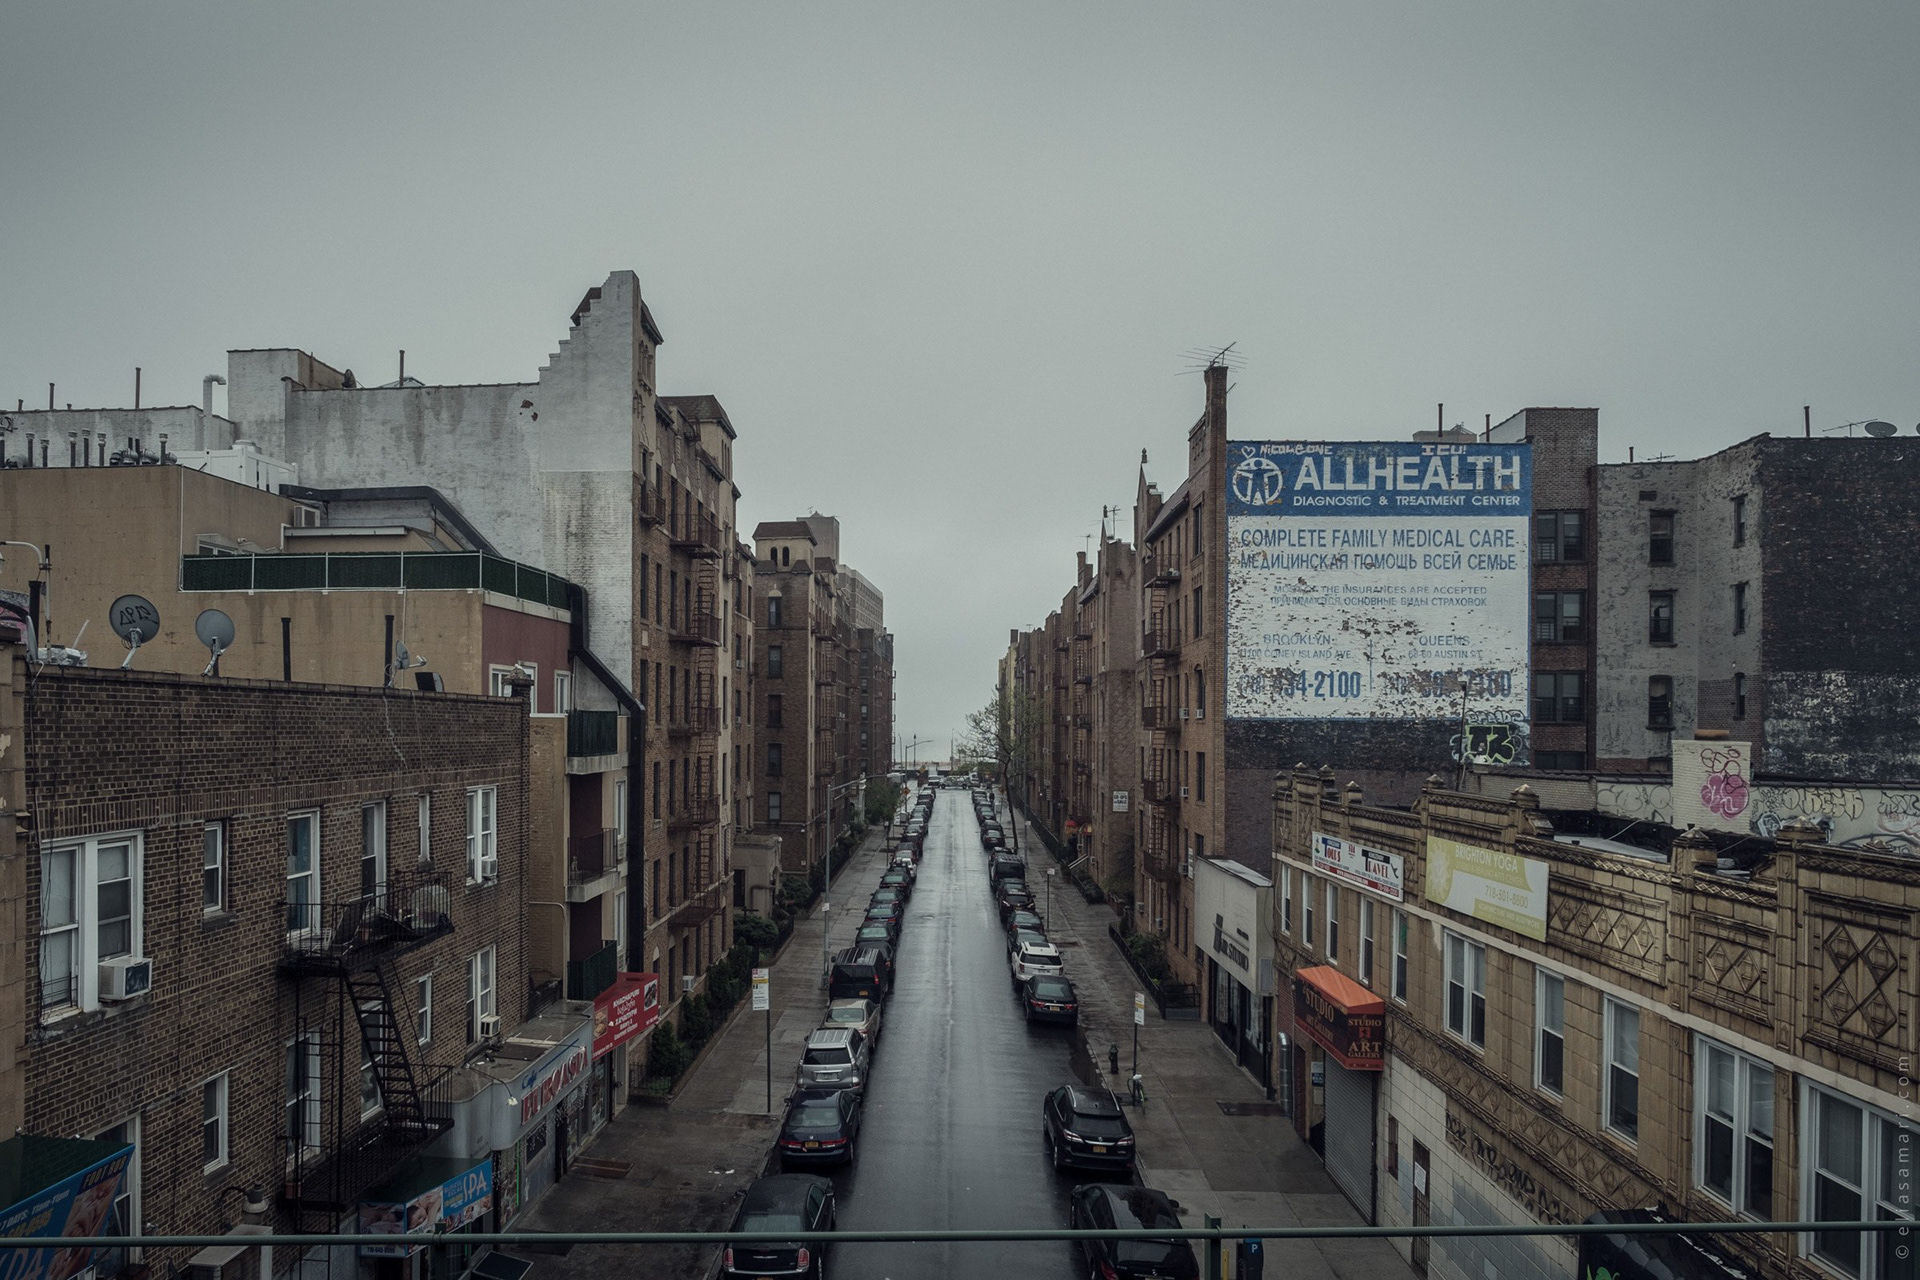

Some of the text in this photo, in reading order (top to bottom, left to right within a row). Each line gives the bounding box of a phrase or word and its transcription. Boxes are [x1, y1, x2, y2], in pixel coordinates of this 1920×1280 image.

[1293, 456, 1520, 490] ALLHEALTH
[1293, 495, 1520, 506] DIAGNOSTIC & TREATMENT CENTER
[1241, 529, 1515, 547] COMPLETE FAMILY MEDICAL CARE
[1240, 551, 1516, 571] МЕДИЦИНСКАЯ ПОМОЩЬ ВСЕЙ СЕМЬЕ
[1321, 585, 1340, 594] THE
[1343, 585, 1406, 594] INSURANCES
[1410, 585, 1429, 594] ARE
[1433, 585, 1487, 594] ACCEPTED
[1263, 634, 1331, 645] BROOKLYN
[1419, 635, 1470, 646] QUEENS
[1298, 649, 1332, 659] ISLAND
[1434, 650, 1467, 659] AUSTIN
[1455, 844, 1518, 873] BRIGHTON YOGA
[1305, 988, 1335, 1023] STUDIO
[1348, 1018, 1382, 1027] STUDIO
[1348, 1041, 1382, 1052] ART
[83, 1155, 128, 1189] FOOT RUB
[464, 1170, 487, 1202] SPA
[1251, 1243, 1258, 1253] P
